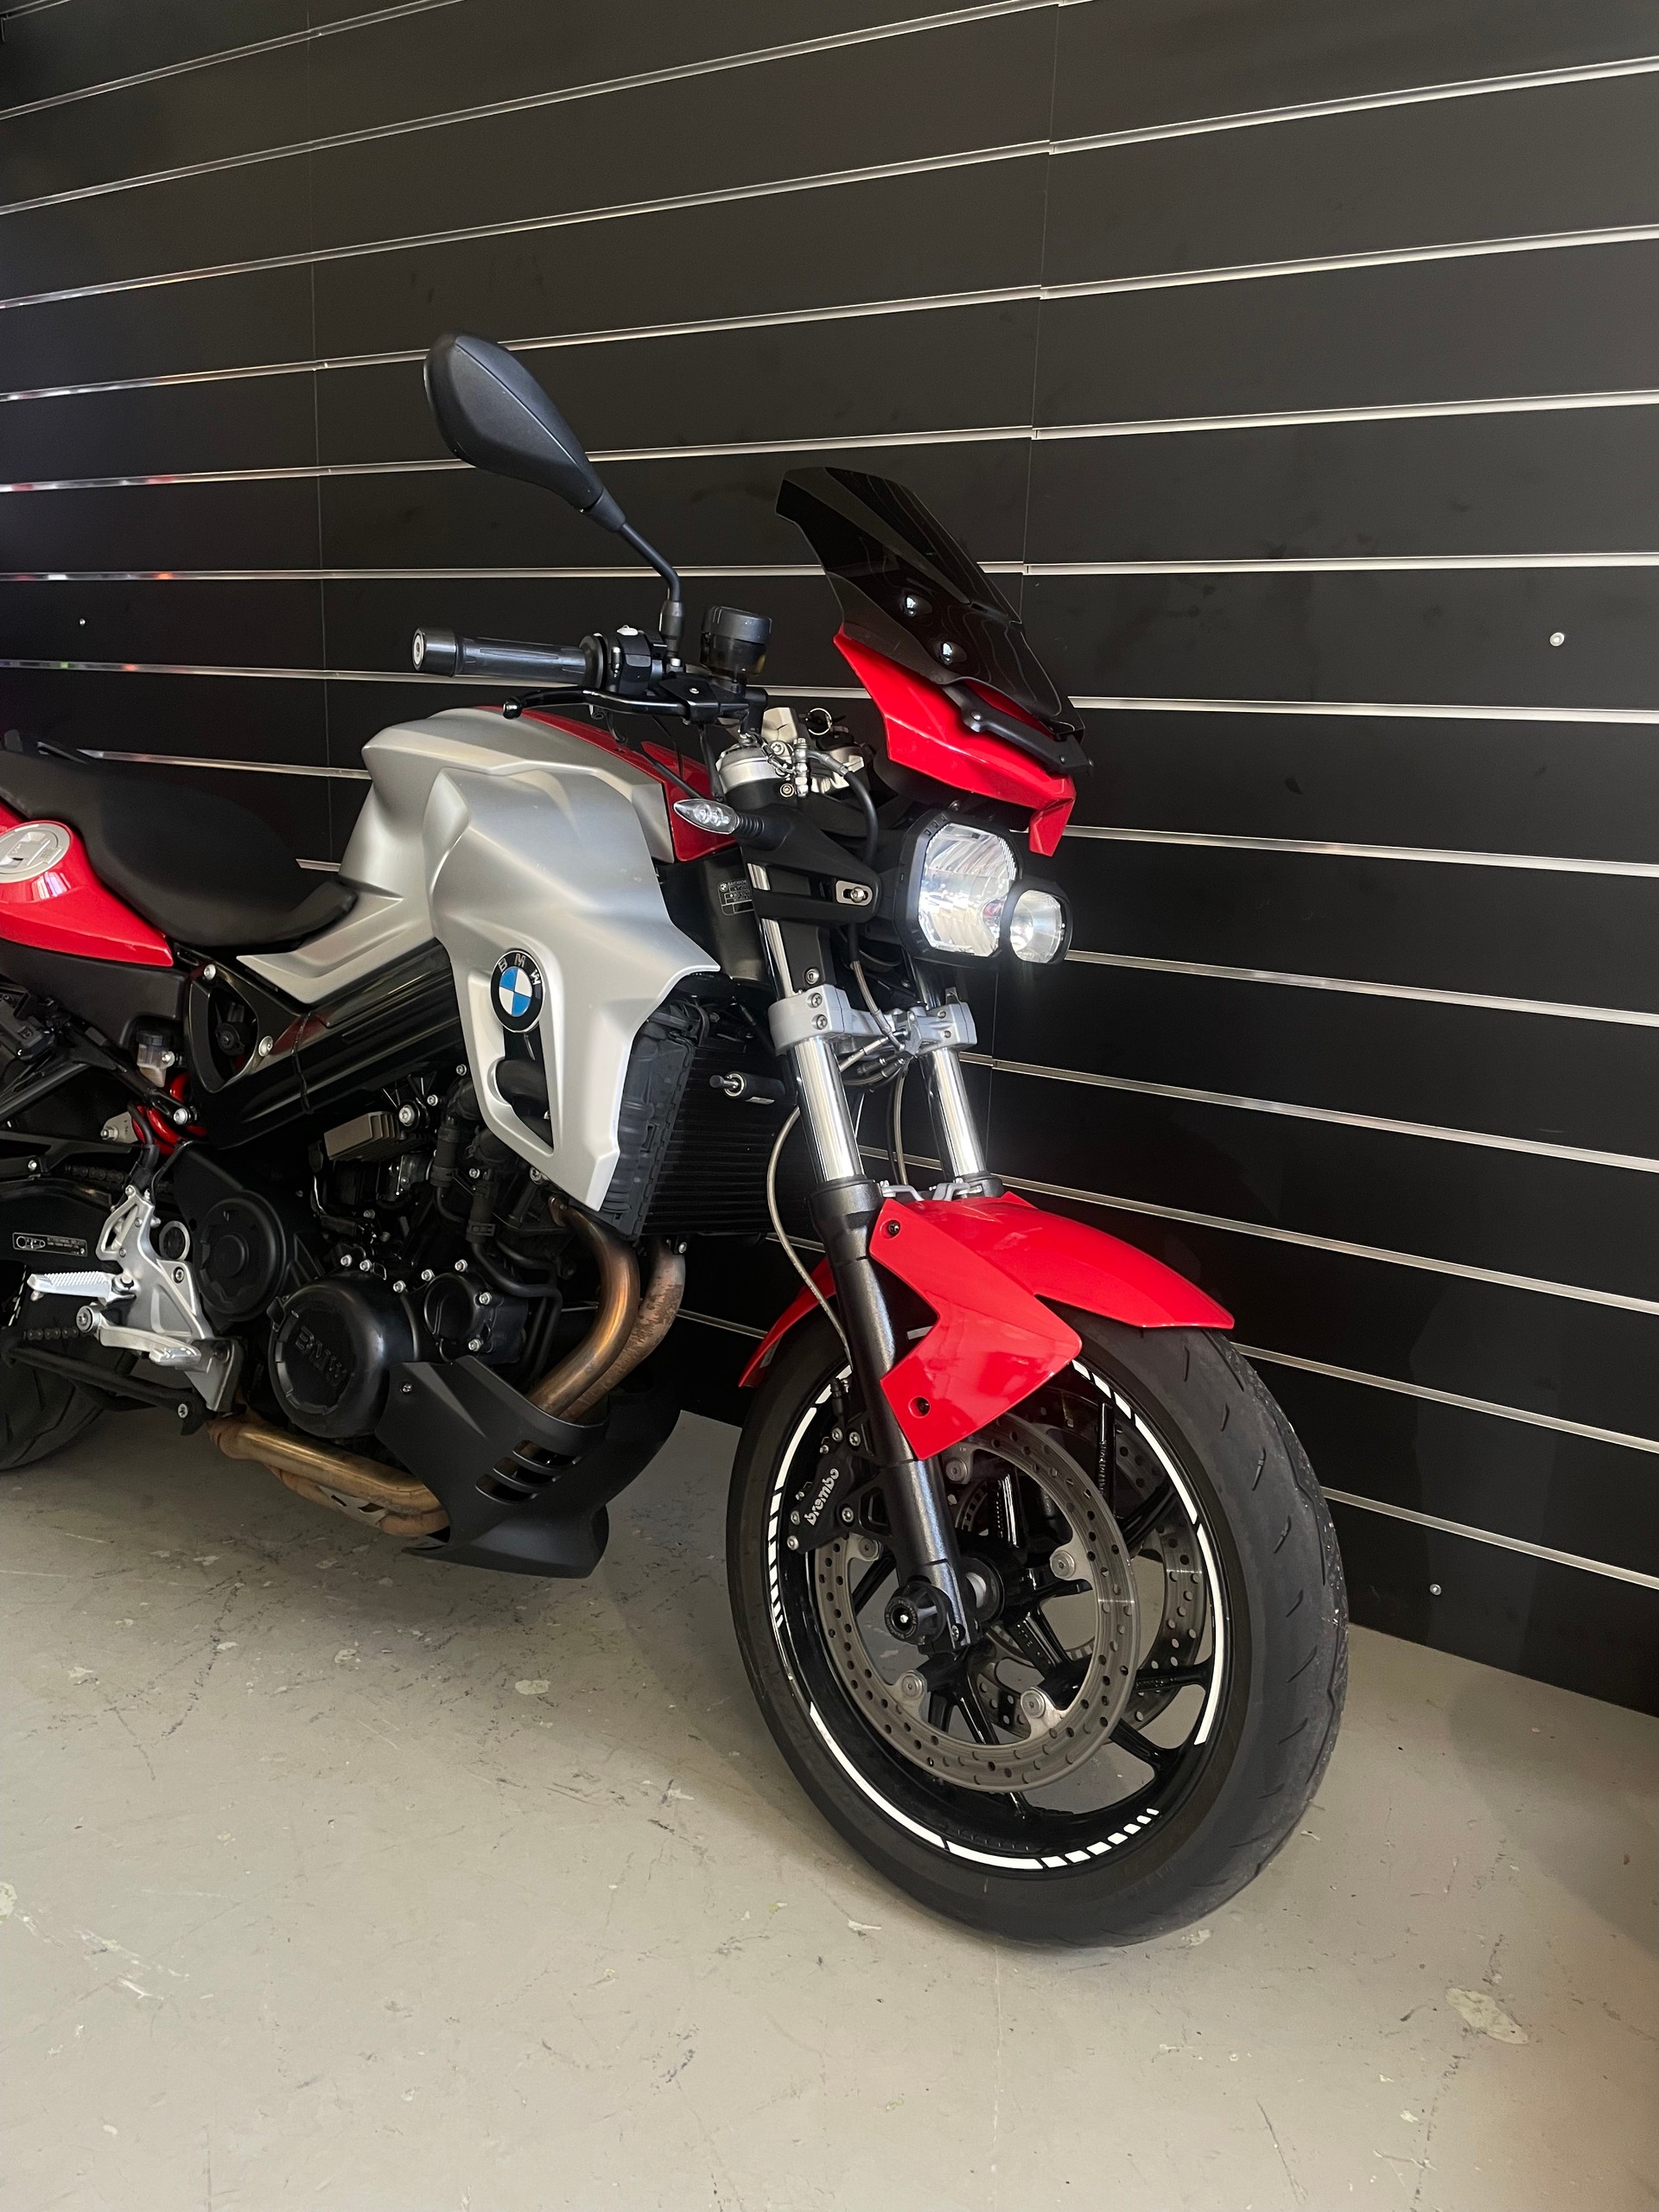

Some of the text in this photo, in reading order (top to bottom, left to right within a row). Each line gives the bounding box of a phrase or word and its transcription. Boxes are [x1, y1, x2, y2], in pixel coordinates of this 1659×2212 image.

[498, 953, 542, 985] BMW
[295, 1325, 348, 1386] BMW
[804, 1468, 840, 1526] brembo
